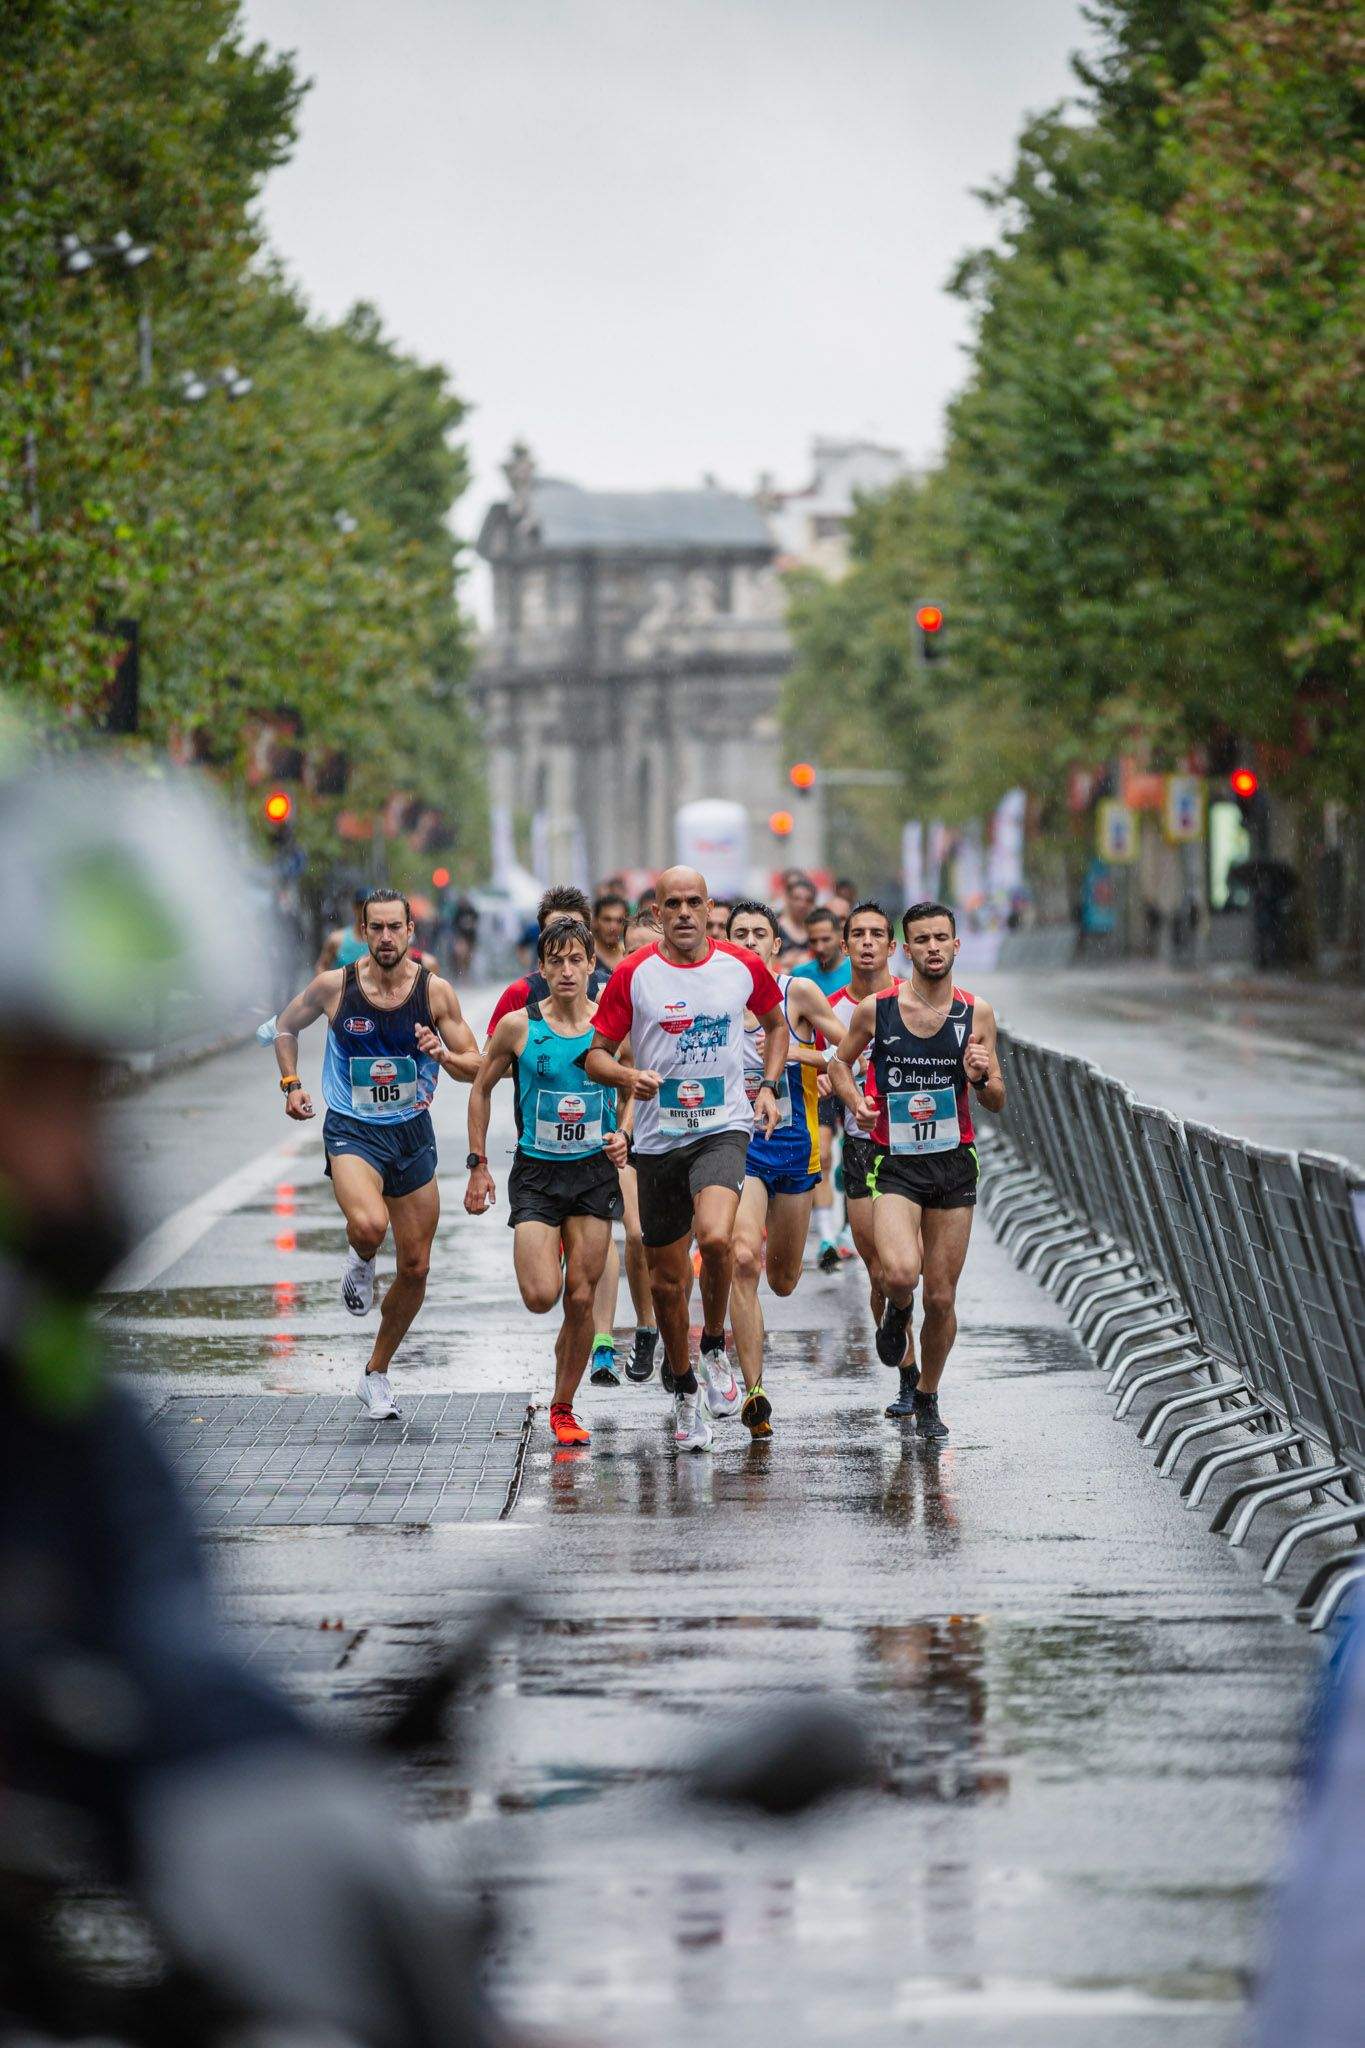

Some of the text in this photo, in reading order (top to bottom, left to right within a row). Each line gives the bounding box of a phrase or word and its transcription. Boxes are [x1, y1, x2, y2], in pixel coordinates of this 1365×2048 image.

[905, 1070, 952, 1088] alquiber
[370, 1085, 400, 1103] 105
[670, 1109, 689, 1118] REYES
[555, 1123, 586, 1141] 150
[687, 1118, 699, 1128] 36
[912, 1121, 937, 1141] 177
